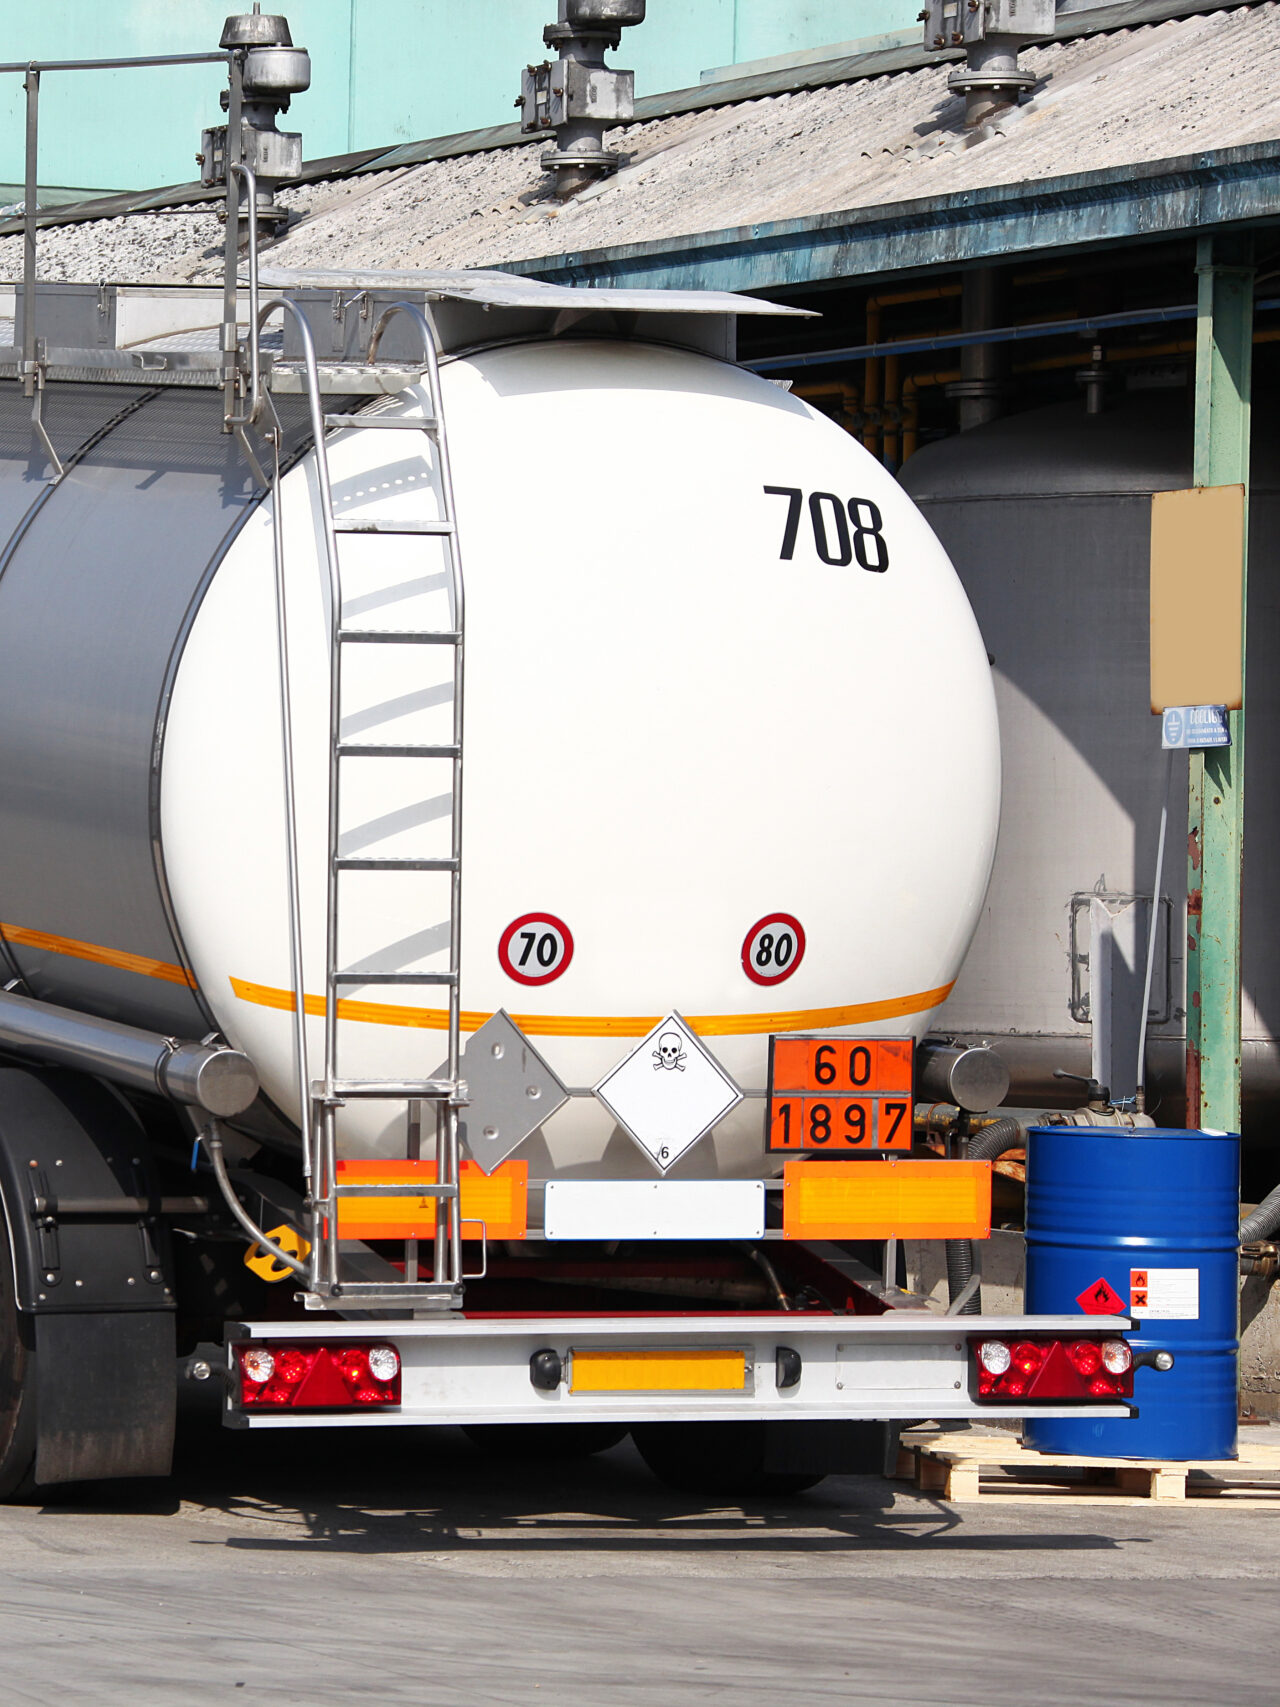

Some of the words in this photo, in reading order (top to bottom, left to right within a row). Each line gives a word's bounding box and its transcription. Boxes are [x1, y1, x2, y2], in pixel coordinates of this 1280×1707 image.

[763, 485, 889, 573] 708
[519, 932, 557, 967] 70
[756, 933, 792, 967] 80
[815, 1045, 871, 1085] 60
[778, 1103, 908, 1144] 1897
[661, 1146, 669, 1159] 6
